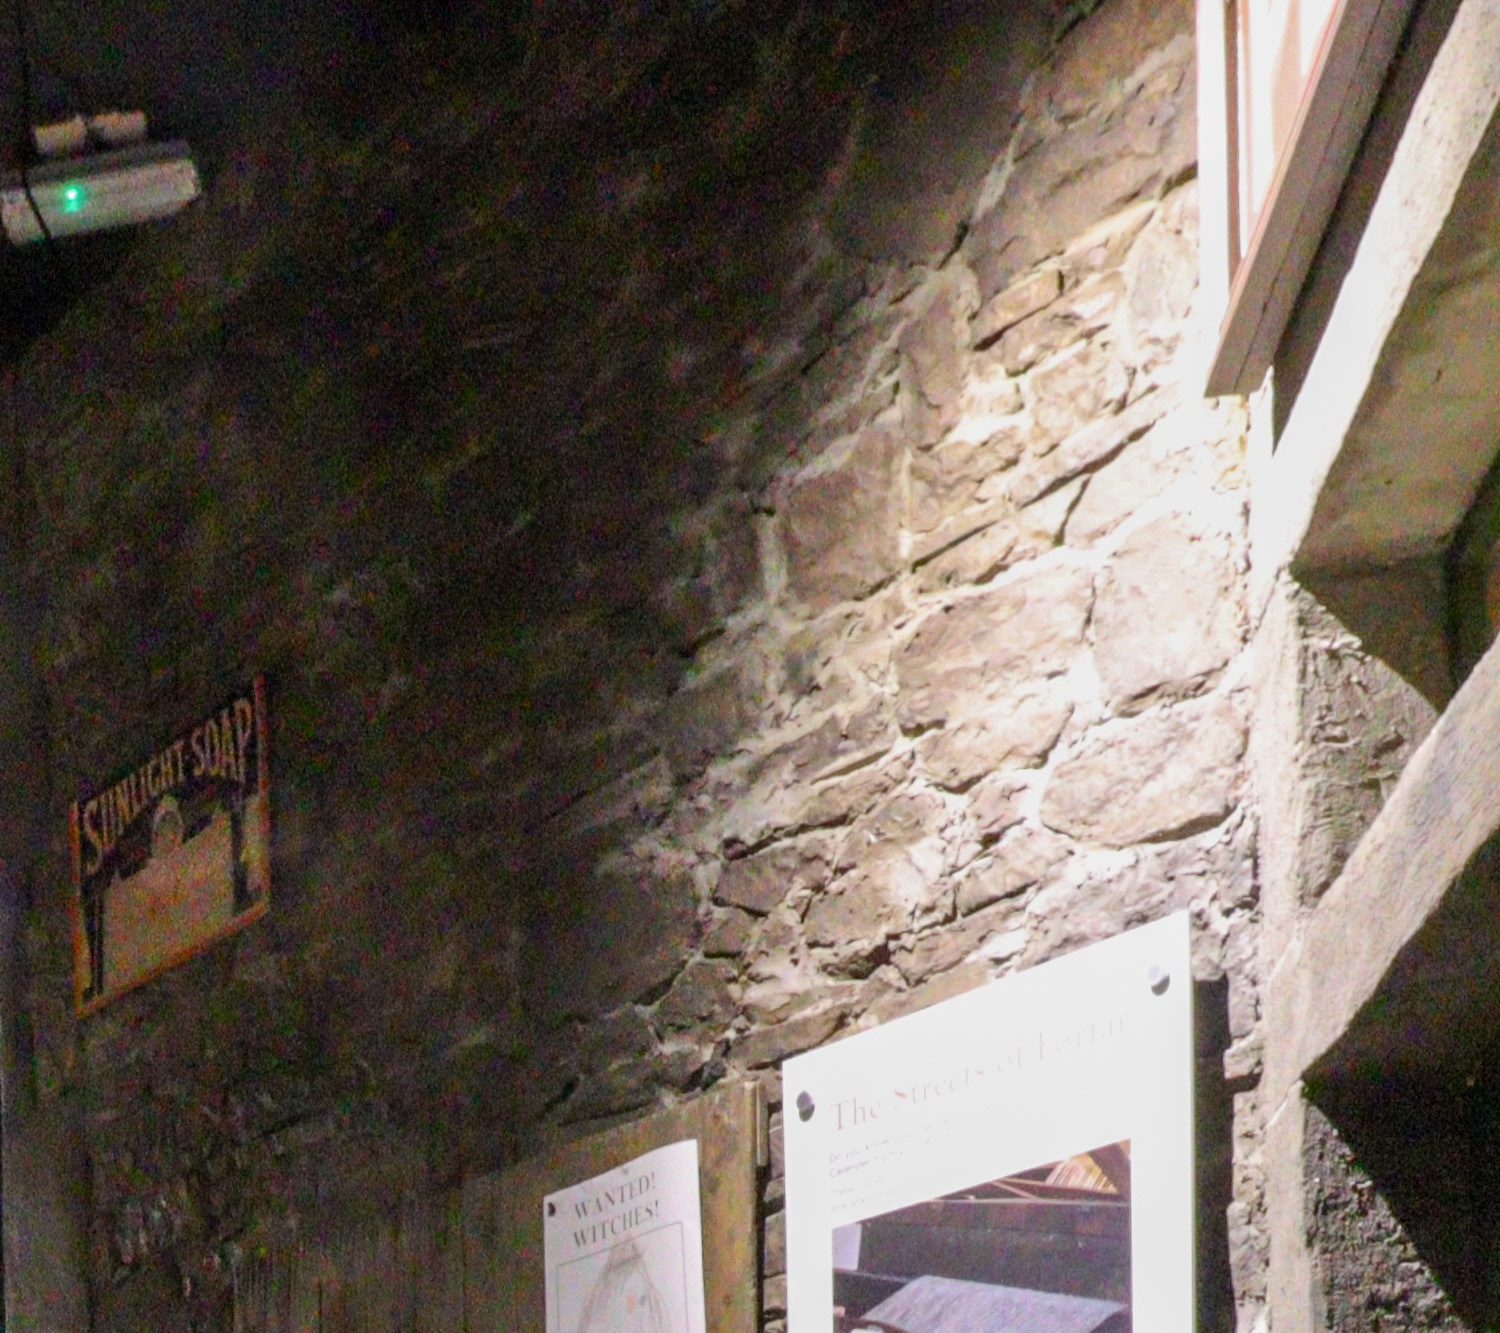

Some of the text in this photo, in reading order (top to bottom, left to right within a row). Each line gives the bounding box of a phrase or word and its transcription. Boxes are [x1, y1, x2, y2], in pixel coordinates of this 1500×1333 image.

[84, 698, 252, 875] SUNLIGHT SOAP
[830, 1097, 881, 1132] The
[894, 1066, 985, 1110] Streets
[1037, 1012, 1129, 1060] Forfar
[573, 1200, 661, 1248] WITCHES!
[574, 1171, 656, 1220] WANTED!
